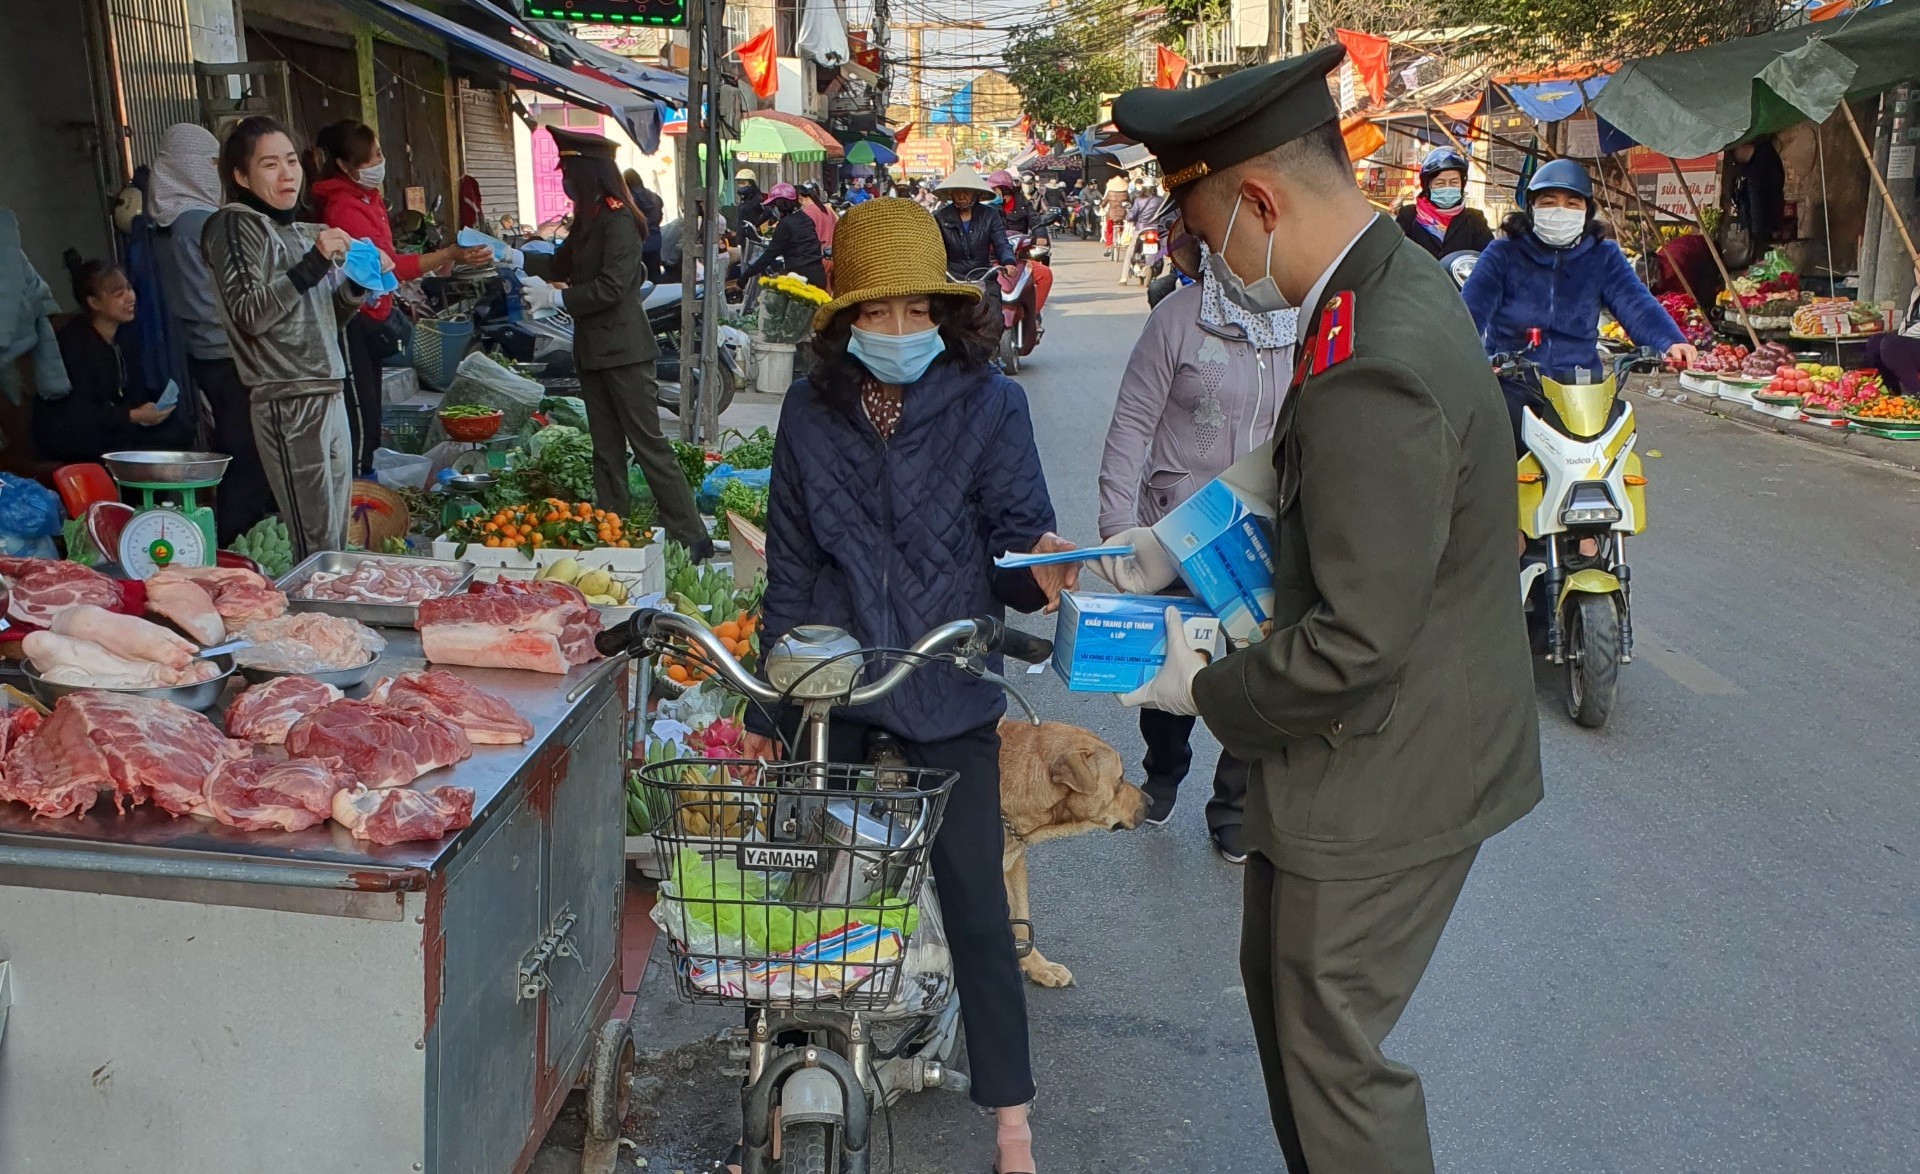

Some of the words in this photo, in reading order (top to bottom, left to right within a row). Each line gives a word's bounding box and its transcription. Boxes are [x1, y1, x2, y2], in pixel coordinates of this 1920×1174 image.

[1661, 181, 1676, 195] SỬA
[1679, 182, 1702, 196] CỮA,
[1102, 620, 1122, 628] TRANG
[1193, 628, 1213, 640] LT
[746, 849, 817, 868] YAMAHA
